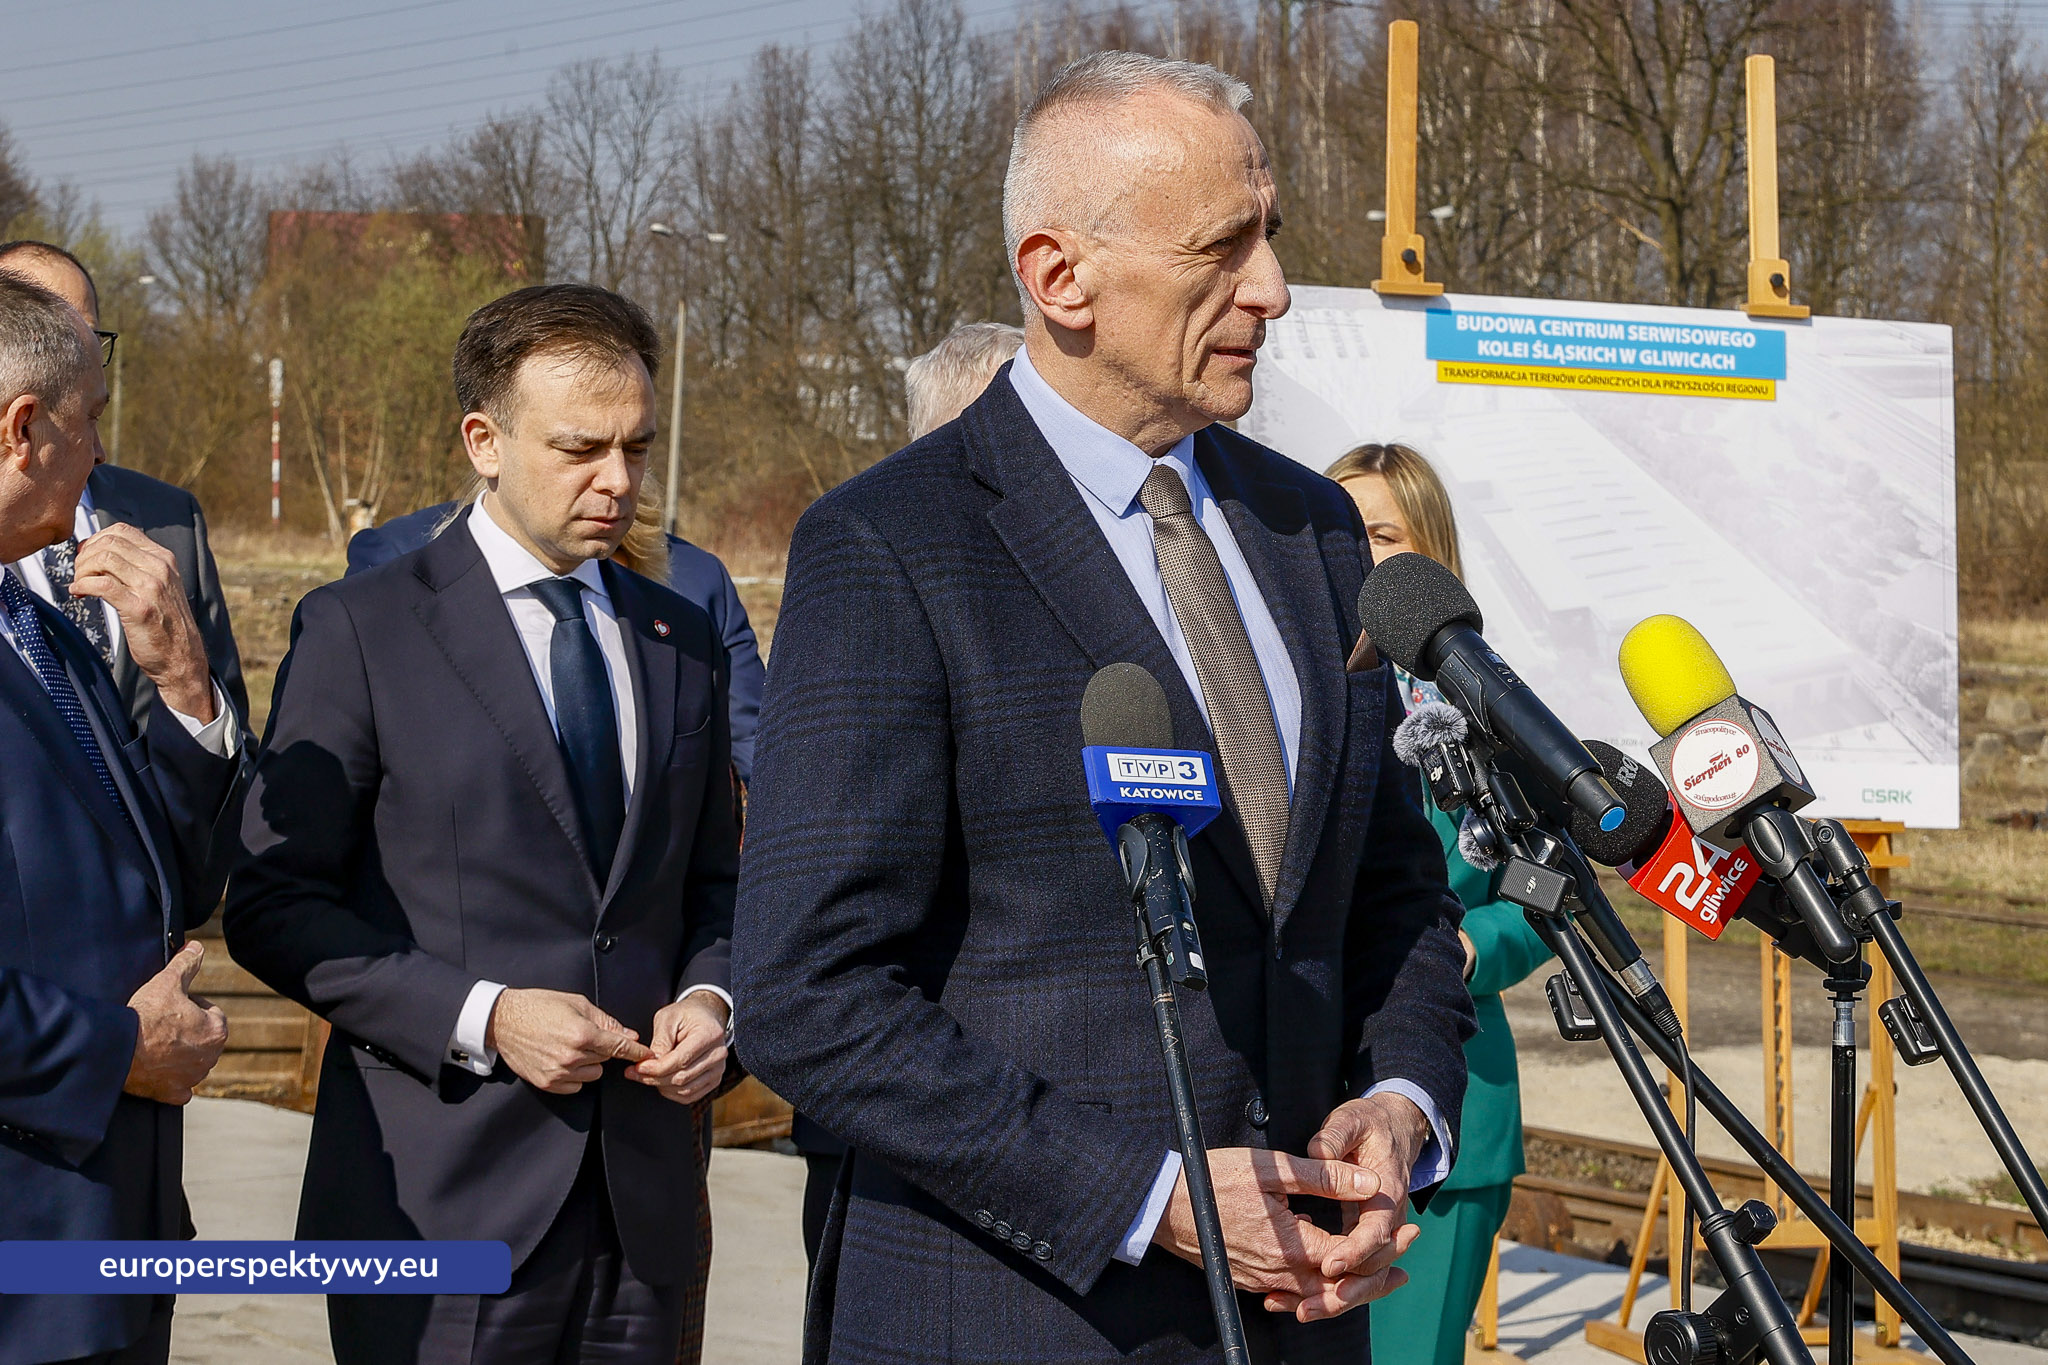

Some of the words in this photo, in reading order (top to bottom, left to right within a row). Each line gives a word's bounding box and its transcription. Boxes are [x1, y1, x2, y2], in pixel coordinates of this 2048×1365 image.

[1456, 314, 1537, 335] BUDOWA
[1540, 319, 1625, 340] CENTRUM
[1628, 324, 1757, 348] SERWISOWEGO
[1477, 339, 1529, 358] KOLEI
[1532, 340, 1617, 364] ŚLĄSKICH
[1619, 348, 1637, 364] W
[1639, 349, 1736, 370] GLIWICACH
[1443, 367, 1528, 381] TRANSFORMACJA
[1529, 371, 1577, 384] TERENÓW
[1578, 375, 1640, 388] GÓRNICZYCH
[1642, 379, 1661, 389] DLA
[1662, 379, 1725, 393] PRZYSZŁOŚCI
[1726, 383, 1769, 396] REGIONU
[1119, 760, 1171, 777] TVP
[1179, 761, 1198, 780] 3
[1683, 754, 1732, 791] Sierpień
[1735, 744, 1750, 758] 80
[1120, 787, 1204, 801] KATOWICE
[1875, 789, 1912, 804] SRK
[1657, 834, 1732, 912] 24
[1699, 857, 1749, 925] gliwice
